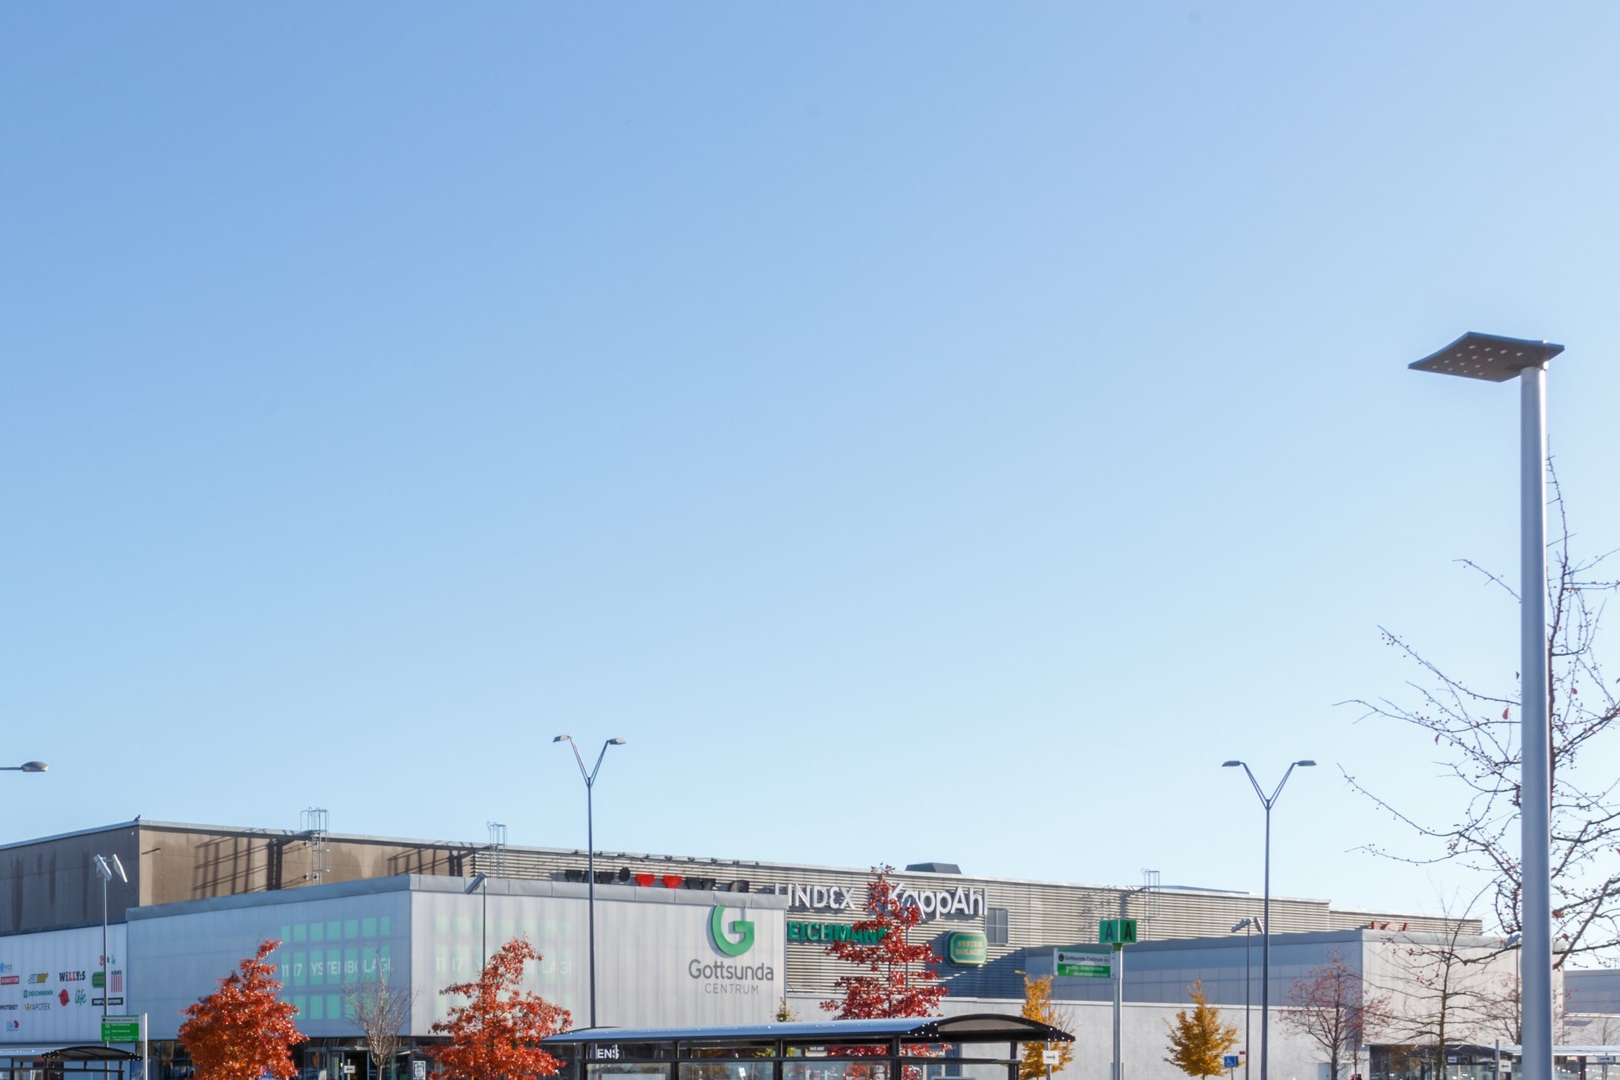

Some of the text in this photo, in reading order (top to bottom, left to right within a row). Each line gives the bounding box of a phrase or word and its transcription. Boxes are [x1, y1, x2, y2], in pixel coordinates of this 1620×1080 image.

[1105, 922, 1114, 941] A
[1124, 922, 1132, 940] A
[688, 959, 775, 982] Gottsunda
[704, 983, 759, 995] CENTRUM
